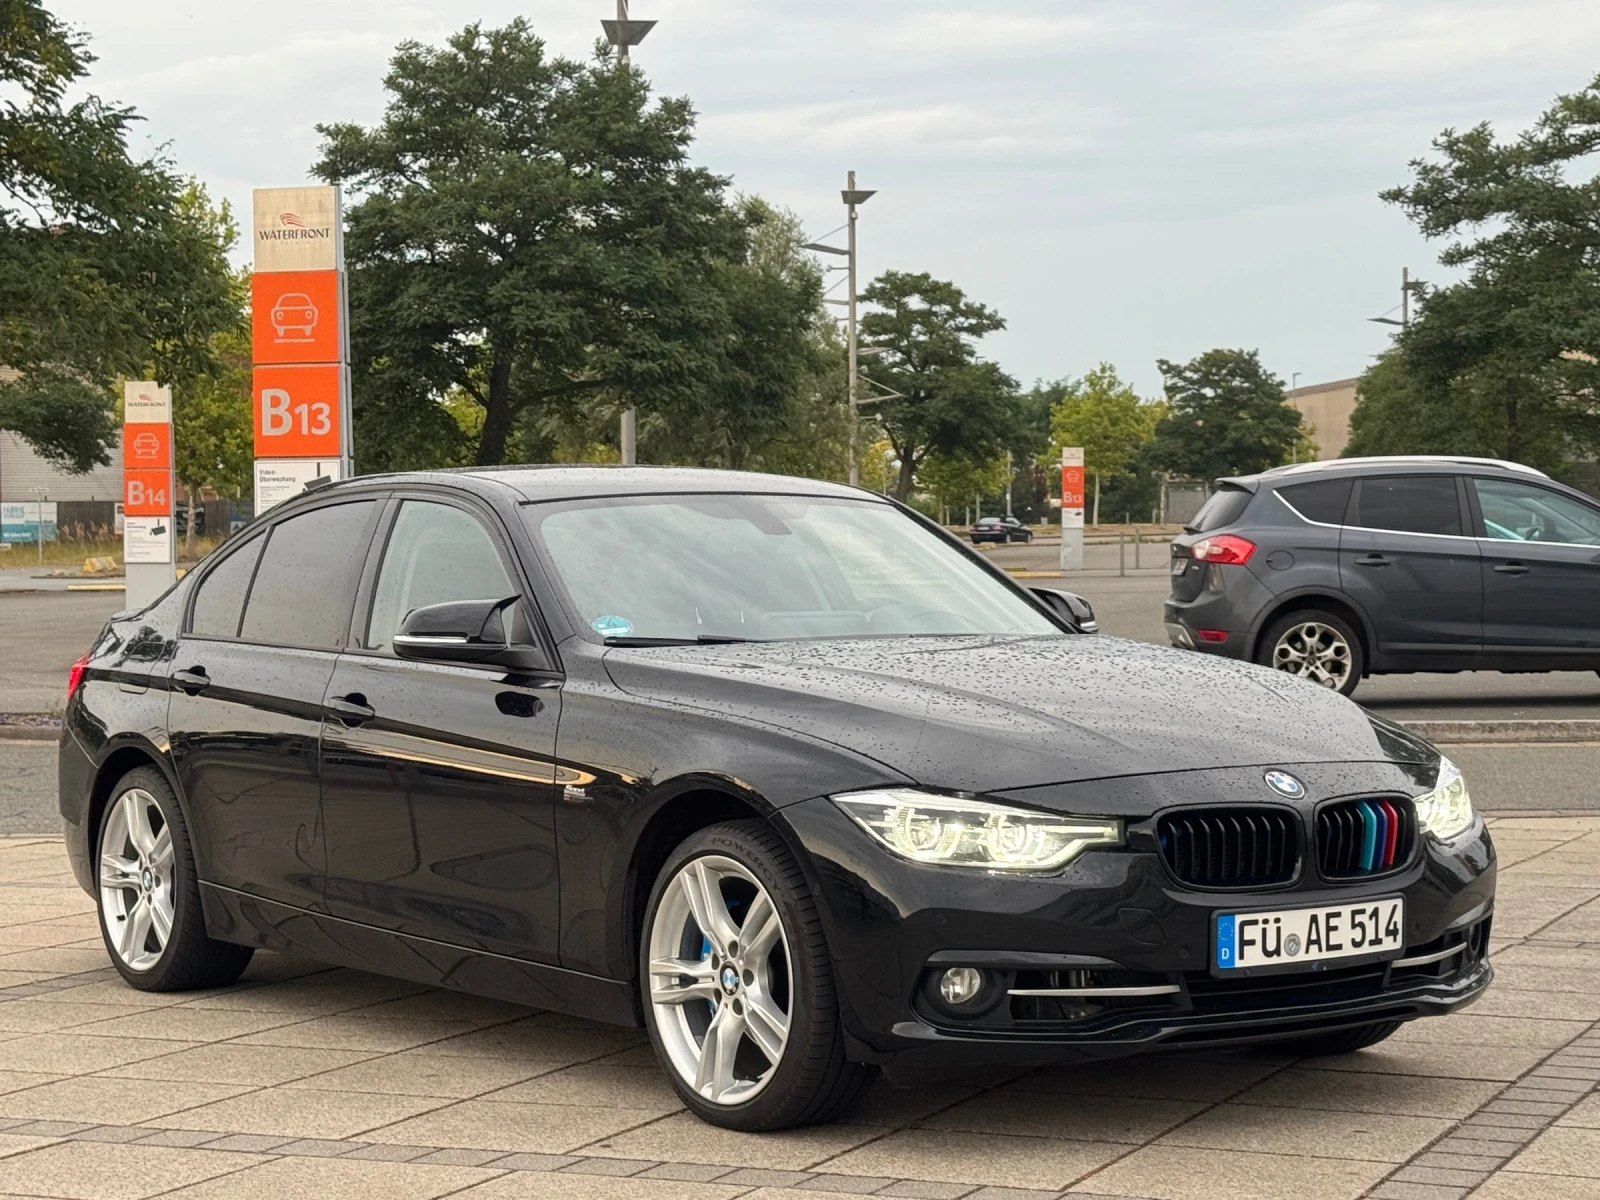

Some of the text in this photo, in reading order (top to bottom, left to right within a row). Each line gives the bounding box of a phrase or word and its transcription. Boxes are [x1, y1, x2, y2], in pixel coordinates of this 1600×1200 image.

[259, 228, 330, 240] WATERFRONT
[261, 388, 331, 436] B13
[127, 480, 166, 506] B14
[1221, 904, 1399, 960] D FÜ AE 514
